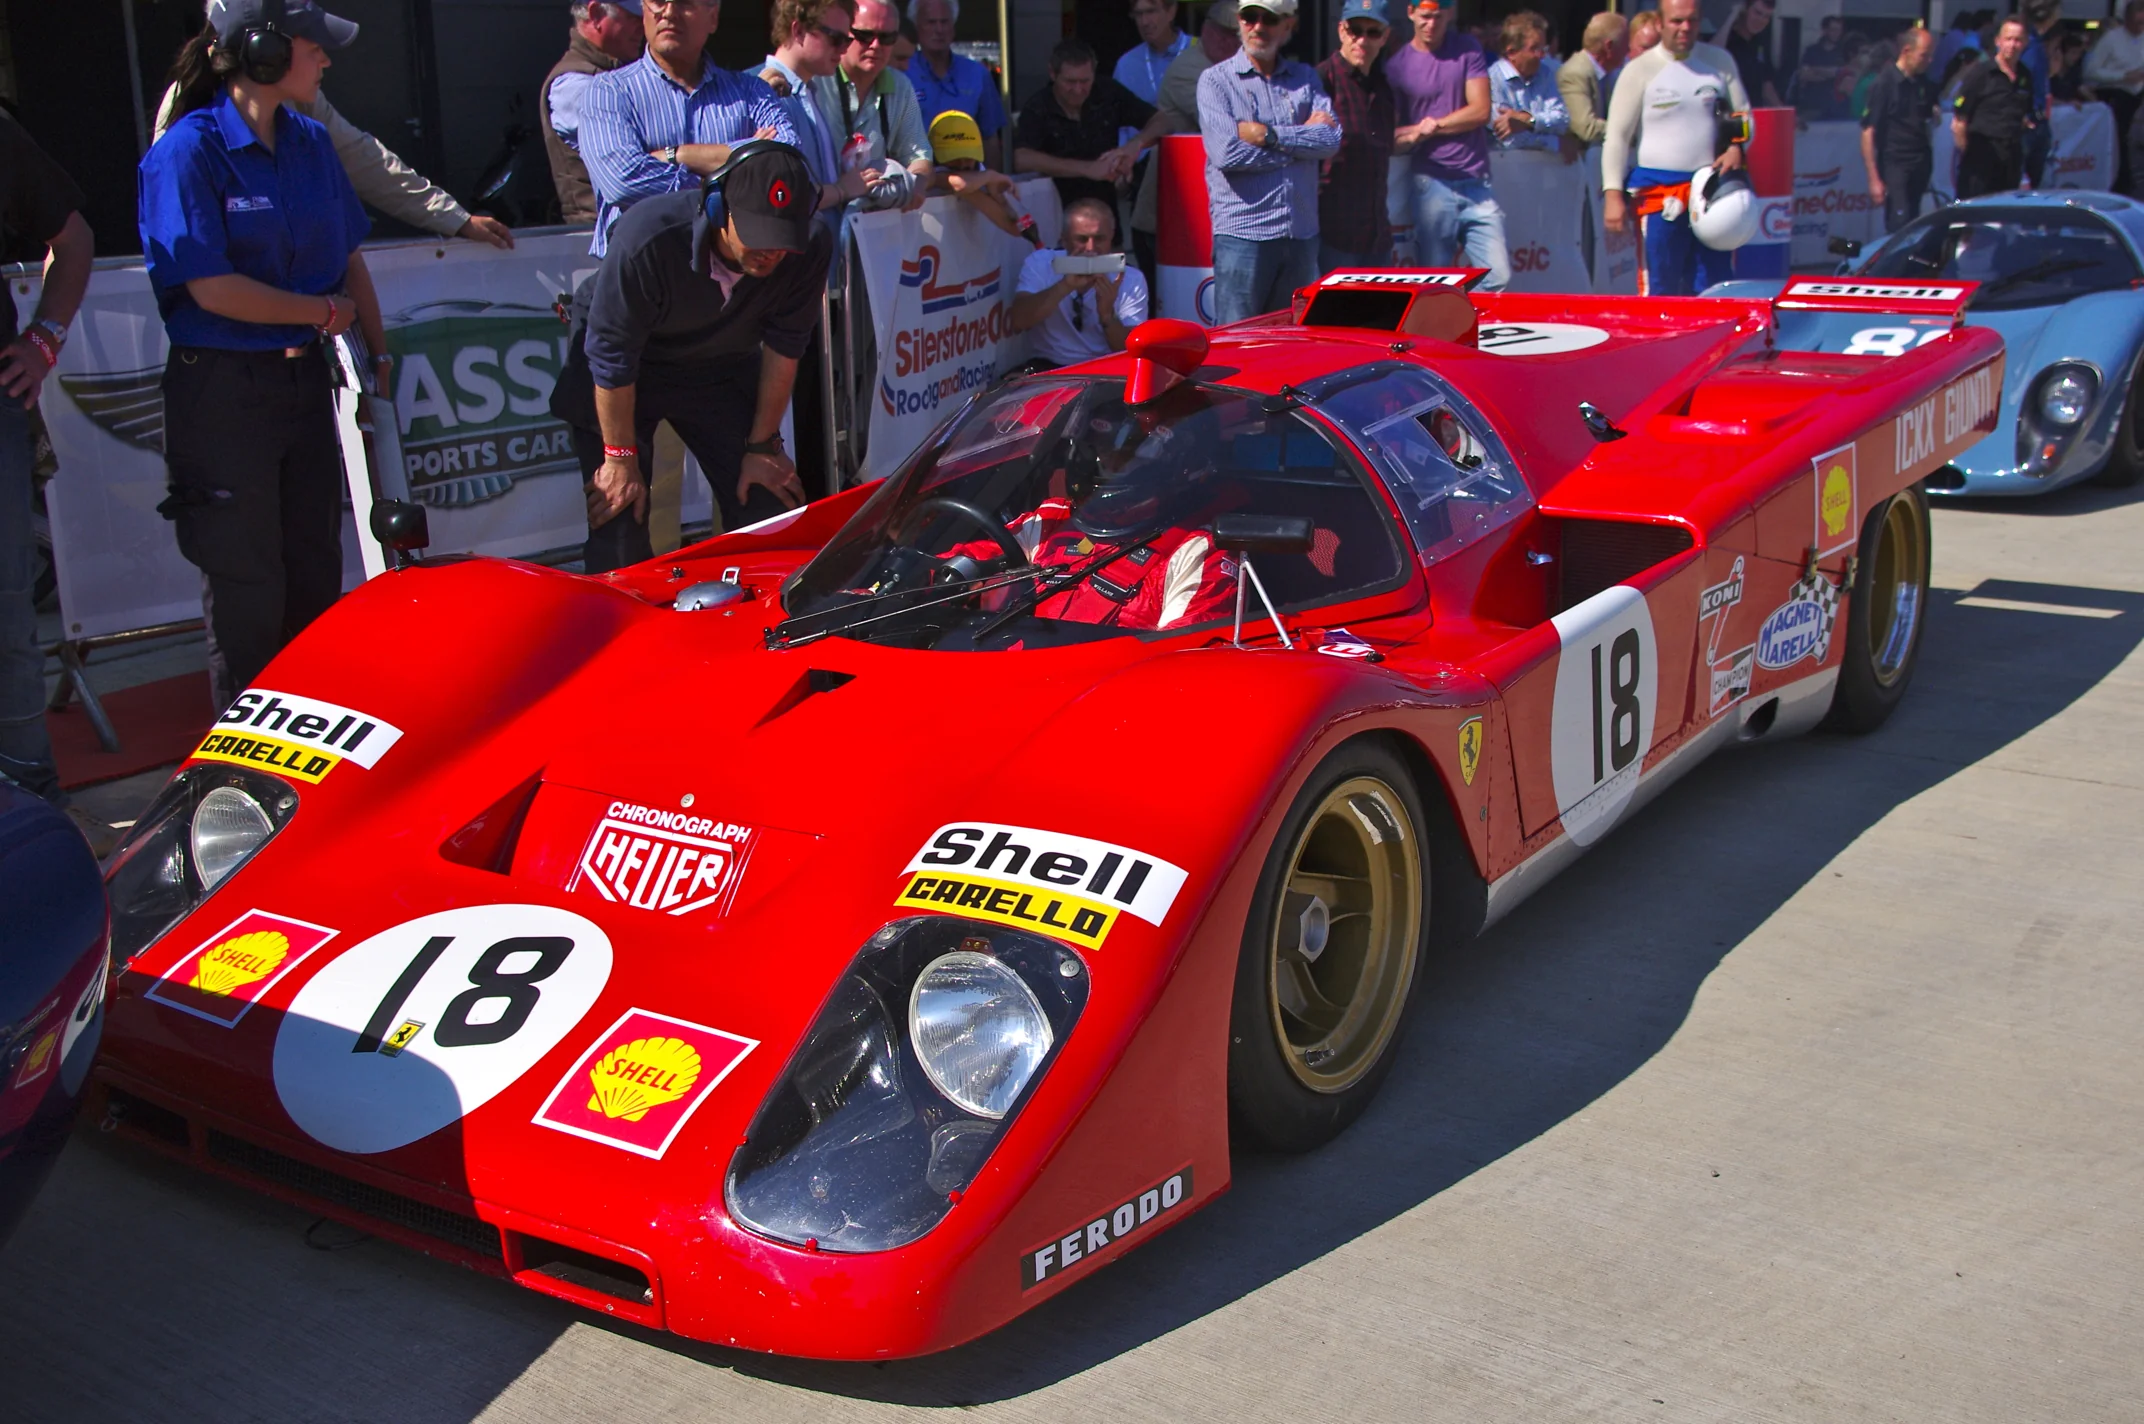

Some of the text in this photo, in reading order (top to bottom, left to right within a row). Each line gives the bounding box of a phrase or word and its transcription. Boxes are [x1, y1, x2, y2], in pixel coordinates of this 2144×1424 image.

[1807, 284, 1943, 297] Shell
[405, 430, 571, 481] PORTS CAR
[1894, 397, 1936, 475] ICKX
[1825, 490, 1847, 512] SHELL
[1702, 581, 1741, 613] KONI
[1714, 663, 1750, 695] CHAMPION
[218, 693, 377, 753] Shell
[1591, 627, 1641, 786] 18
[200, 734, 332, 777] CARELLO
[607, 801, 752, 844] CHRONOGRAPH
[595, 831, 725, 911] HEUER
[921, 828, 1153, 906] Shell
[905, 877, 1108, 939] CARELLO
[212, 948, 267, 975] SHELL
[351, 936, 576, 1054] 18
[606, 1058, 679, 1093] SHELL
[1034, 1174, 1184, 1283] FERODO
